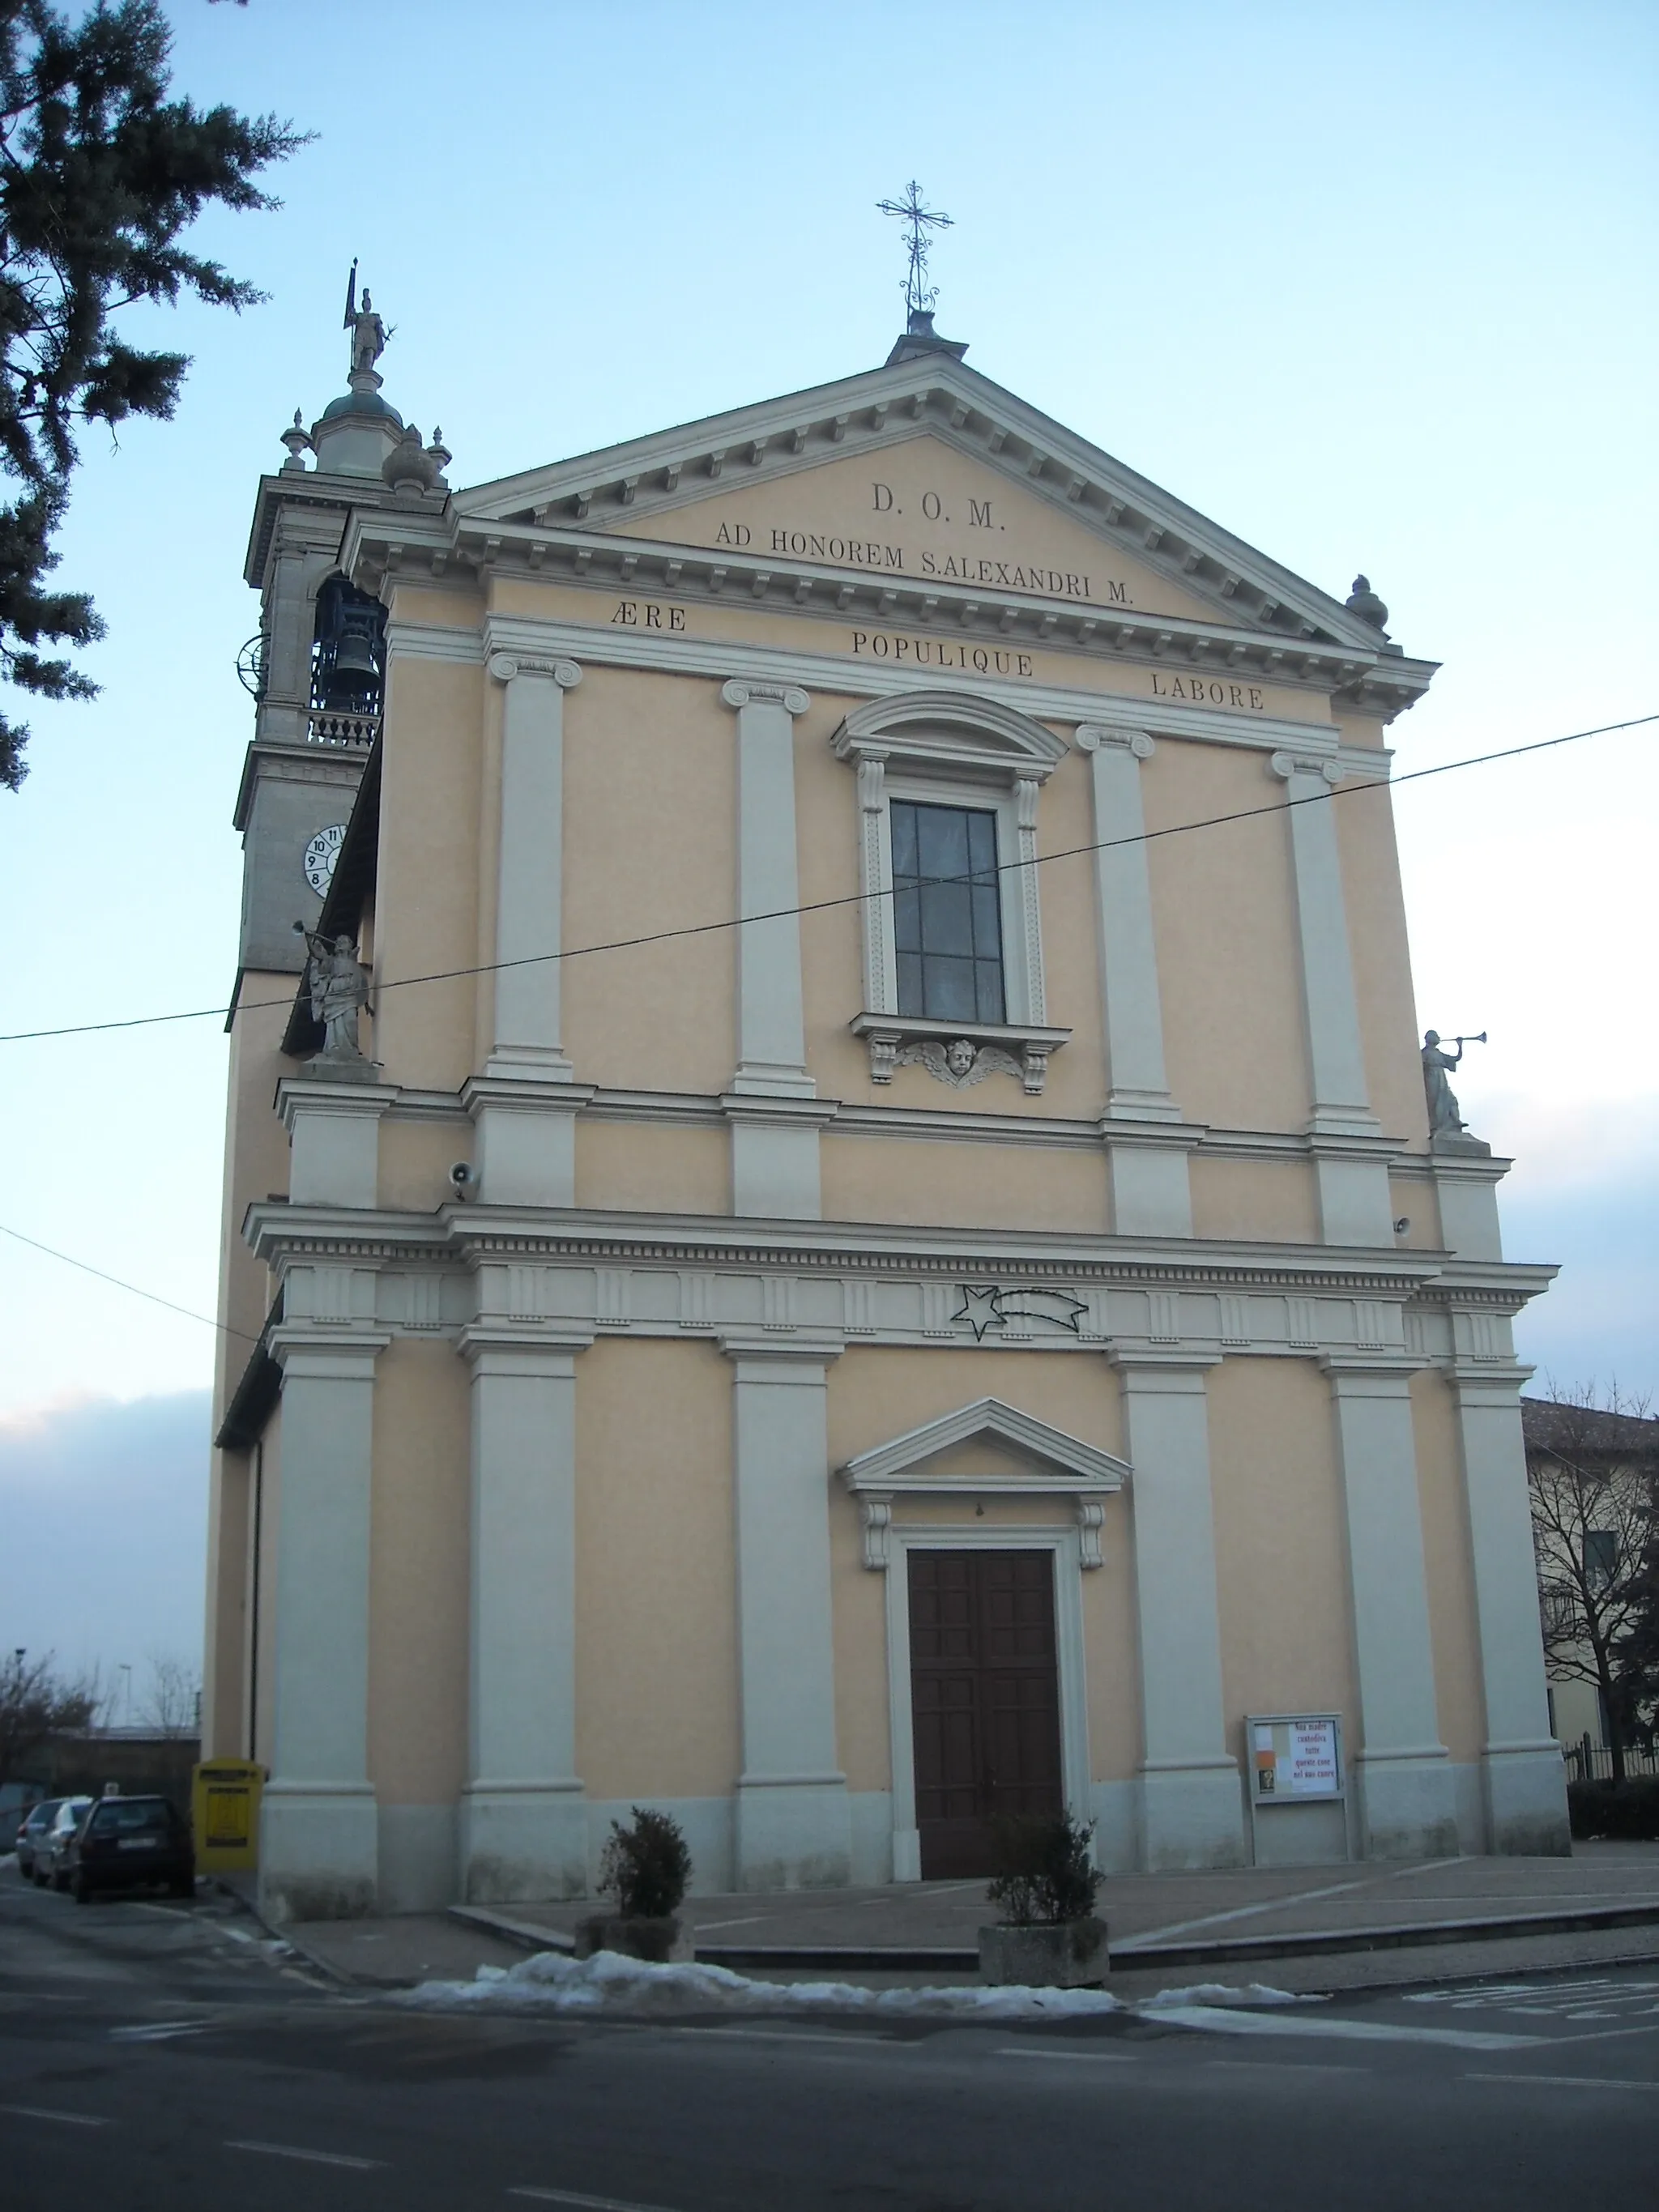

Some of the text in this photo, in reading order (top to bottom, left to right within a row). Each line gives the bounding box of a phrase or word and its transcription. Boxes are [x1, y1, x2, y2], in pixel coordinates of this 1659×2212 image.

[872, 483, 1005, 531] D. O. M.
[715, 522, 751, 547] AD
[770, 529, 904, 569] HONOREM
[1108, 580, 1134, 604] M.
[611, 602, 1264, 710] ÆRE POPULIQUE LABORE
[329, 830, 337, 841] 11
[313, 841, 325, 852] 10
[308, 856, 316, 867] 9
[311, 873, 319, 884] 8
